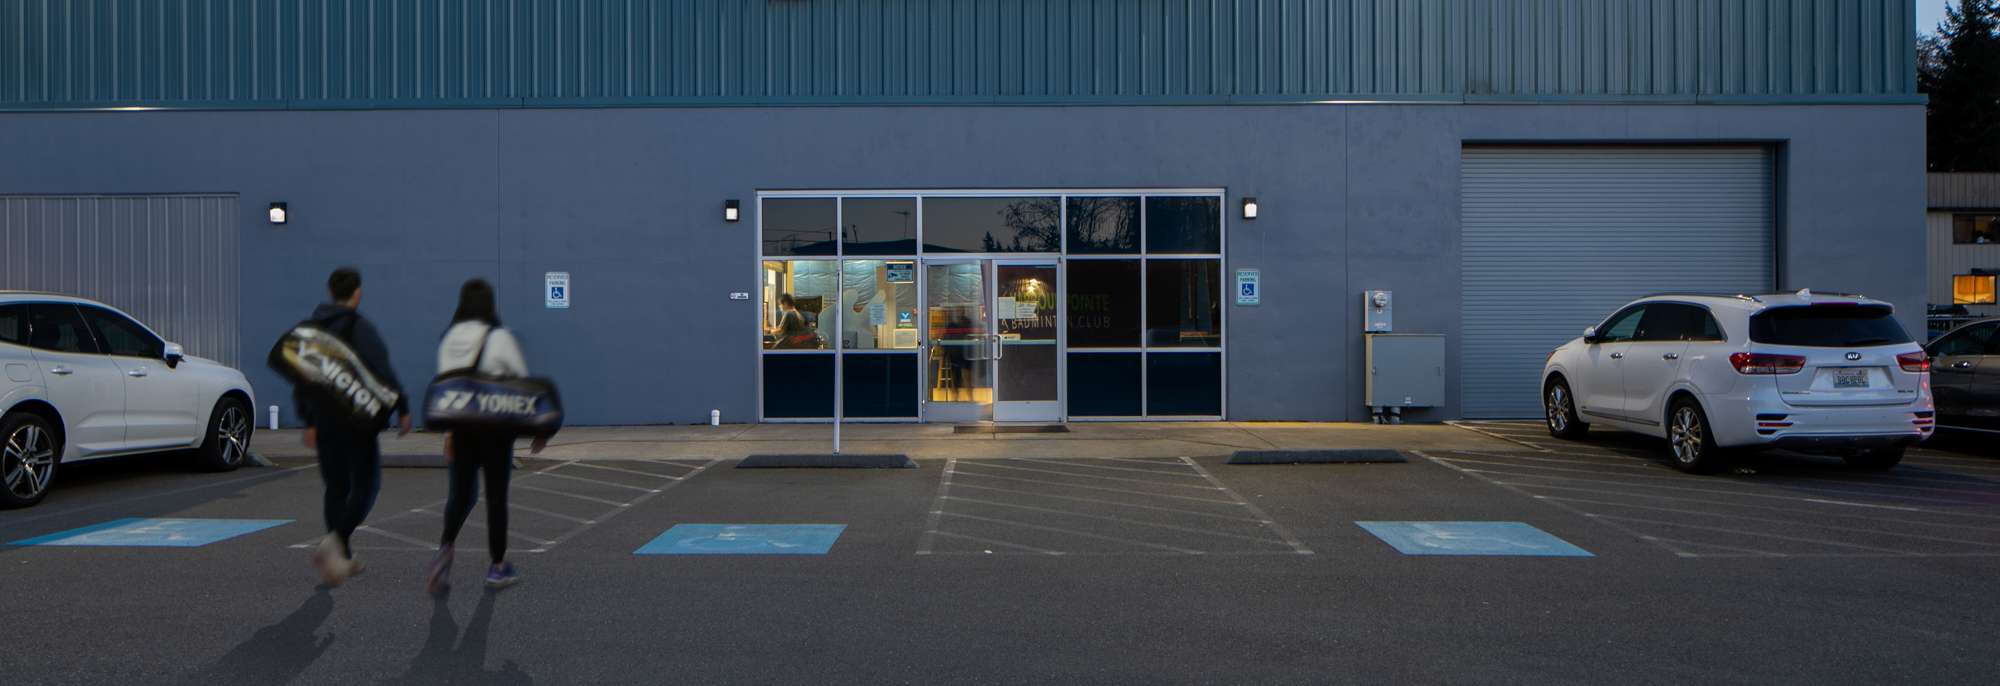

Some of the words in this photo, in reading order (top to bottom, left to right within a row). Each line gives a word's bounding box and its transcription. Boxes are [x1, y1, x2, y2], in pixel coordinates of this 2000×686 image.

[1011, 315, 1073, 330] BADMINTN
[1078, 315, 1111, 329] CLUB
[320, 354, 382, 420] VICTOR
[475, 393, 537, 415] YONEX
